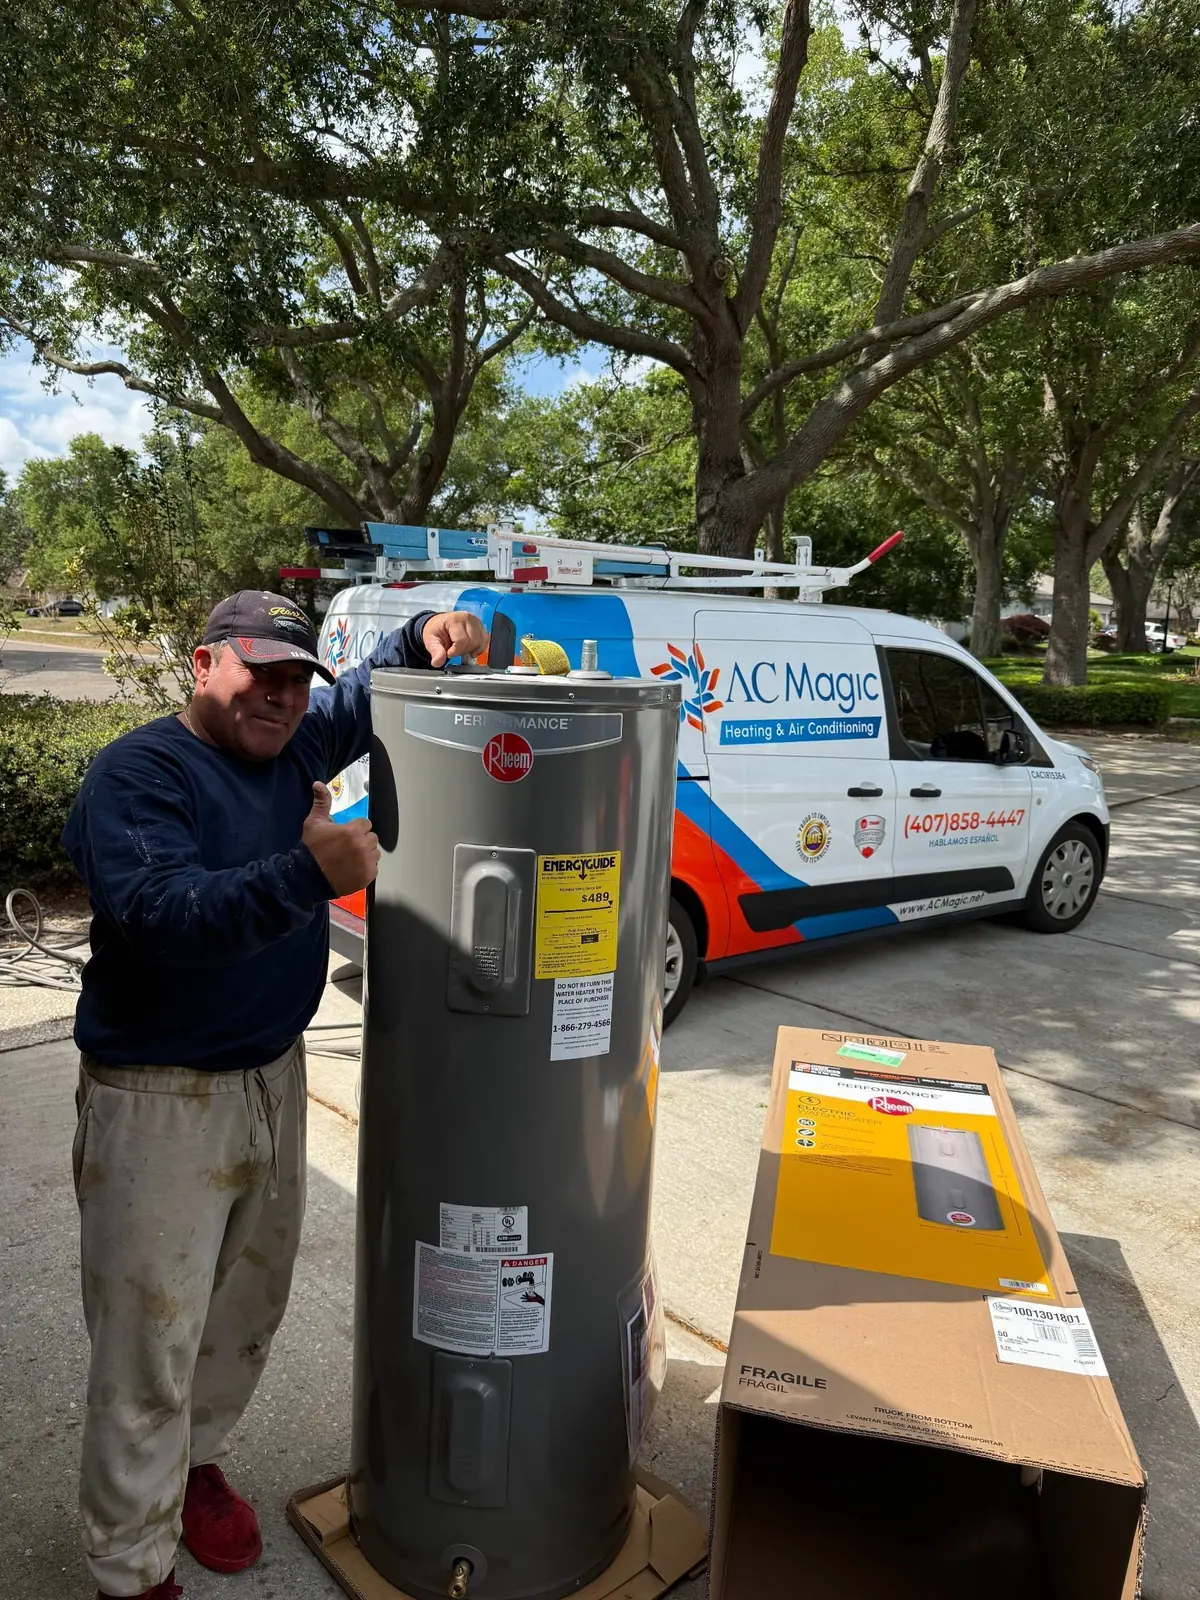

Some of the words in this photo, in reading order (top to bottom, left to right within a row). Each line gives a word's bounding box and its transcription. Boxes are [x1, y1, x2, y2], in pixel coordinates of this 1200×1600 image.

[725, 661, 780, 704] AC
[785, 662, 880, 714] Magic
[454, 713, 568, 730] PERRMANCE
[725, 725, 772, 741] Heating
[776, 723, 785, 736] &
[788, 722, 804, 736] Air
[808, 721, 875, 737] Conditioning
[488, 733, 530, 775] Rheem
[904, 809, 1025, 839] (407)858-4447
[929, 837, 968, 848] HABLAMOS
[969, 834, 999, 845] ESPAÑOL
[543, 857, 616, 872] ENERGYGUIDE
[581, 892, 609, 903] $489
[900, 893, 985, 915] www.ACMagic.net
[580, 980, 600, 988] RETURN
[584, 995, 609, 1003] PURCHASE
[553, 1018, 611, 1032] 1-866-279-4566
[837, 1082, 940, 1100] PERFORMANCE
[798, 1104, 856, 1117] ELECTRIC
[872, 1096, 913, 1114] Rheem
[512, 1258, 545, 1267] DANGER
[1013, 1307, 1080, 1324] 1001301801
[738, 1377, 788, 1394] FRÁGIL
[740, 1364, 827, 1390] FRAGILE
[873, 1406, 904, 1417] TRUCK
[906, 1412, 932, 1422] FROM
[934, 1417, 973, 1430] BOTTOM
[846, 1414, 882, 1424] LEVANTAR
[883, 1420, 905, 1428] DESDE
[907, 1424, 930, 1433] ABAJO
[931, 1428, 951, 1436] PARA
[952, 1431, 1004, 1447] TRANSPORTAR
